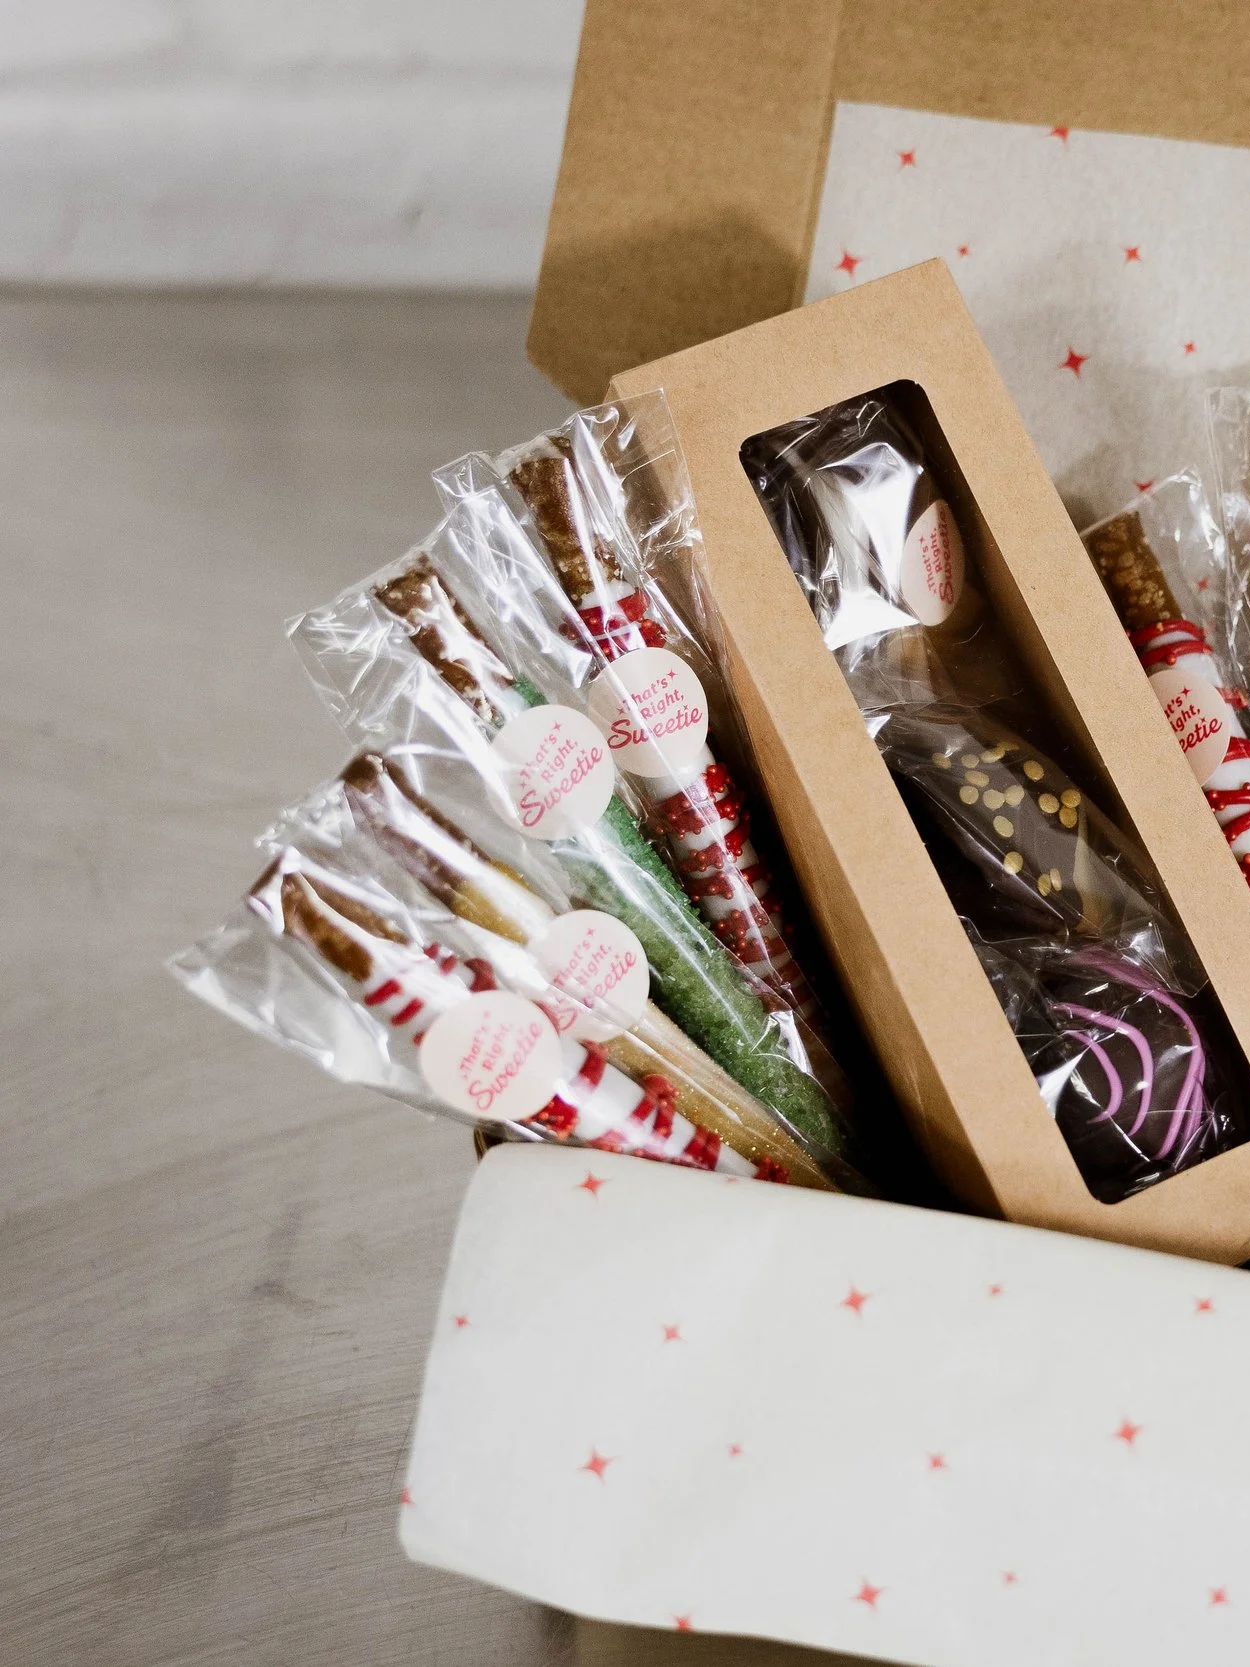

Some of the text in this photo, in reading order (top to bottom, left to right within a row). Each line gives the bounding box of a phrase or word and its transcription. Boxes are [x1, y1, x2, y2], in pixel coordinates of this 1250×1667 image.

[922, 545, 935, 591] That's
[640, 689, 684, 720] Right,
[1170, 705, 1200, 732] ight,
[520, 734, 557, 779] That's
[541, 739, 578, 783] Right,
[520, 747, 602, 827] Sweetie
[468, 1023, 543, 1111] Sweetie
